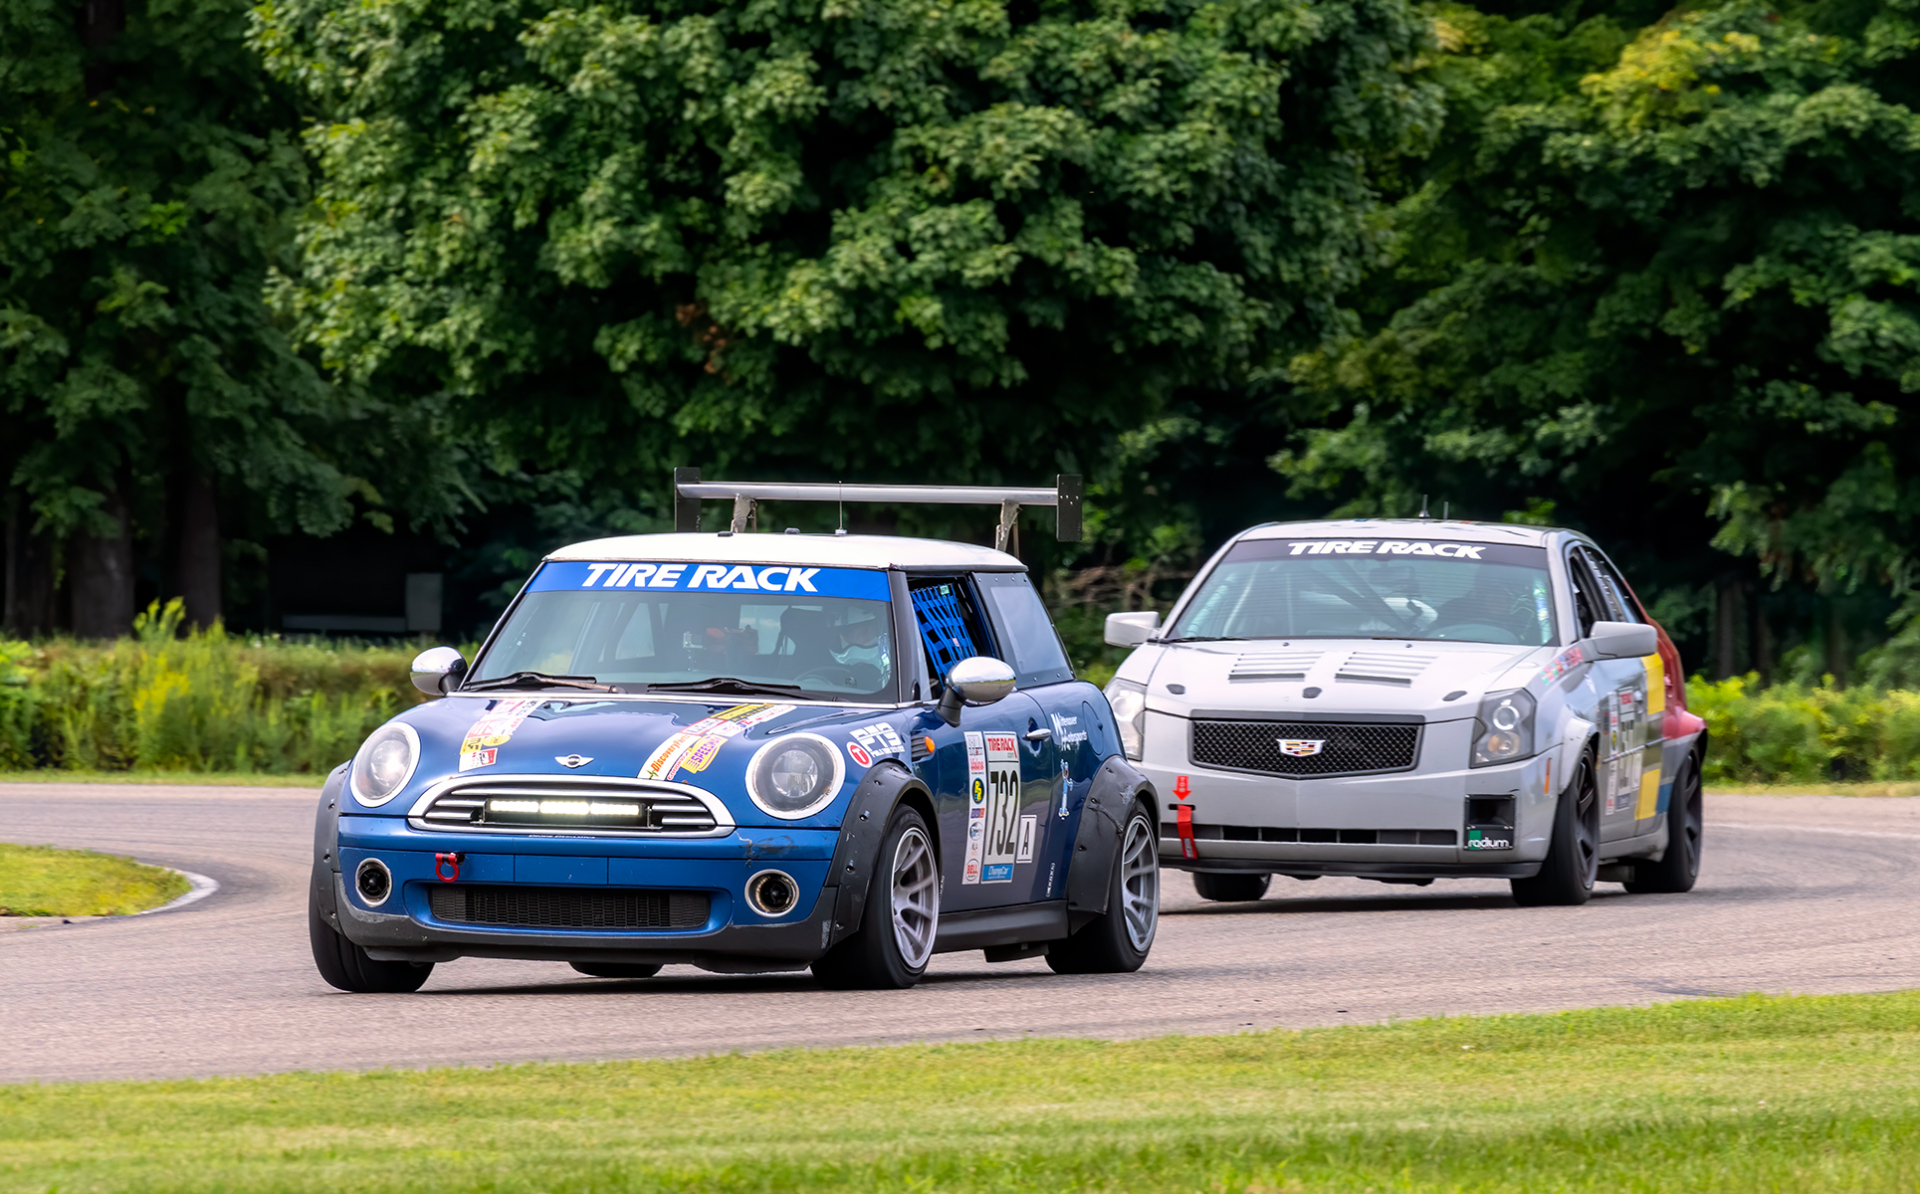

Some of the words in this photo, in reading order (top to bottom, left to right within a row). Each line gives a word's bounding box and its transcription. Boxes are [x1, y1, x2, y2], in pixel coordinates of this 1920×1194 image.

[1288, 541, 1378, 555] TIRE
[1376, 541, 1486, 559] RACK
[582, 563, 688, 587] TIRE
[687, 565, 821, 592] RACK
[987, 738, 1001, 751] TIRE
[1000, 738, 1018, 758] RACK
[988, 769, 1019, 856] 732
[1021, 821, 1030, 856] A
[1467, 836, 1510, 849] radium
